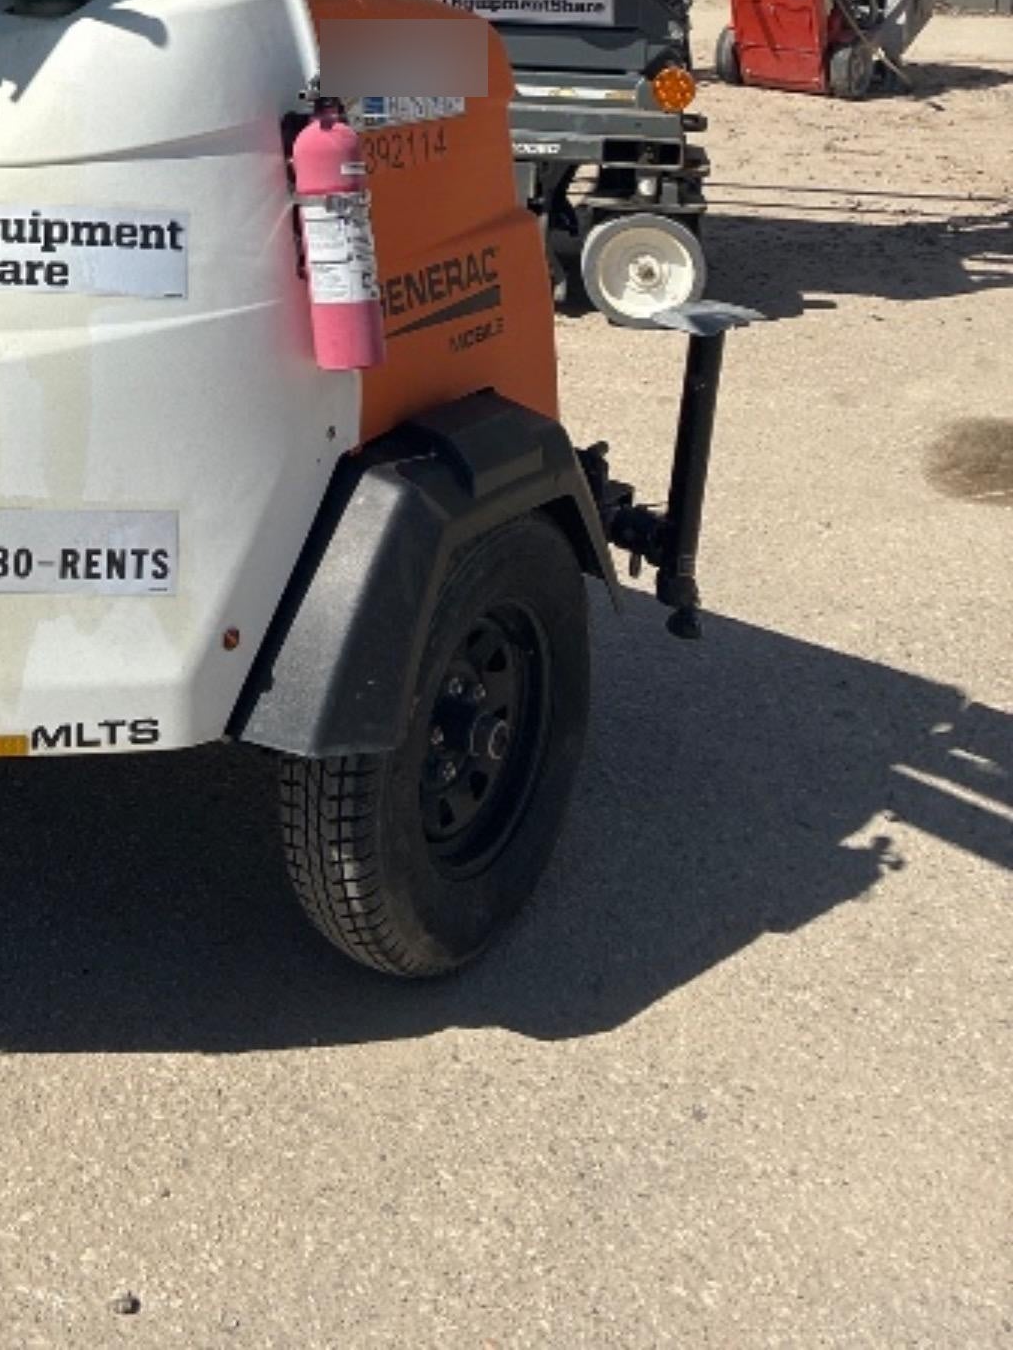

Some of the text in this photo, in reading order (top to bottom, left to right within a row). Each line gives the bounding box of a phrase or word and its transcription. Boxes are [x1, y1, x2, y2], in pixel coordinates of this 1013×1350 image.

[364, 127, 447, 174] 392114
[450, 316, 504, 352] MOBILE
[31, 718, 160, 749] MLTS
